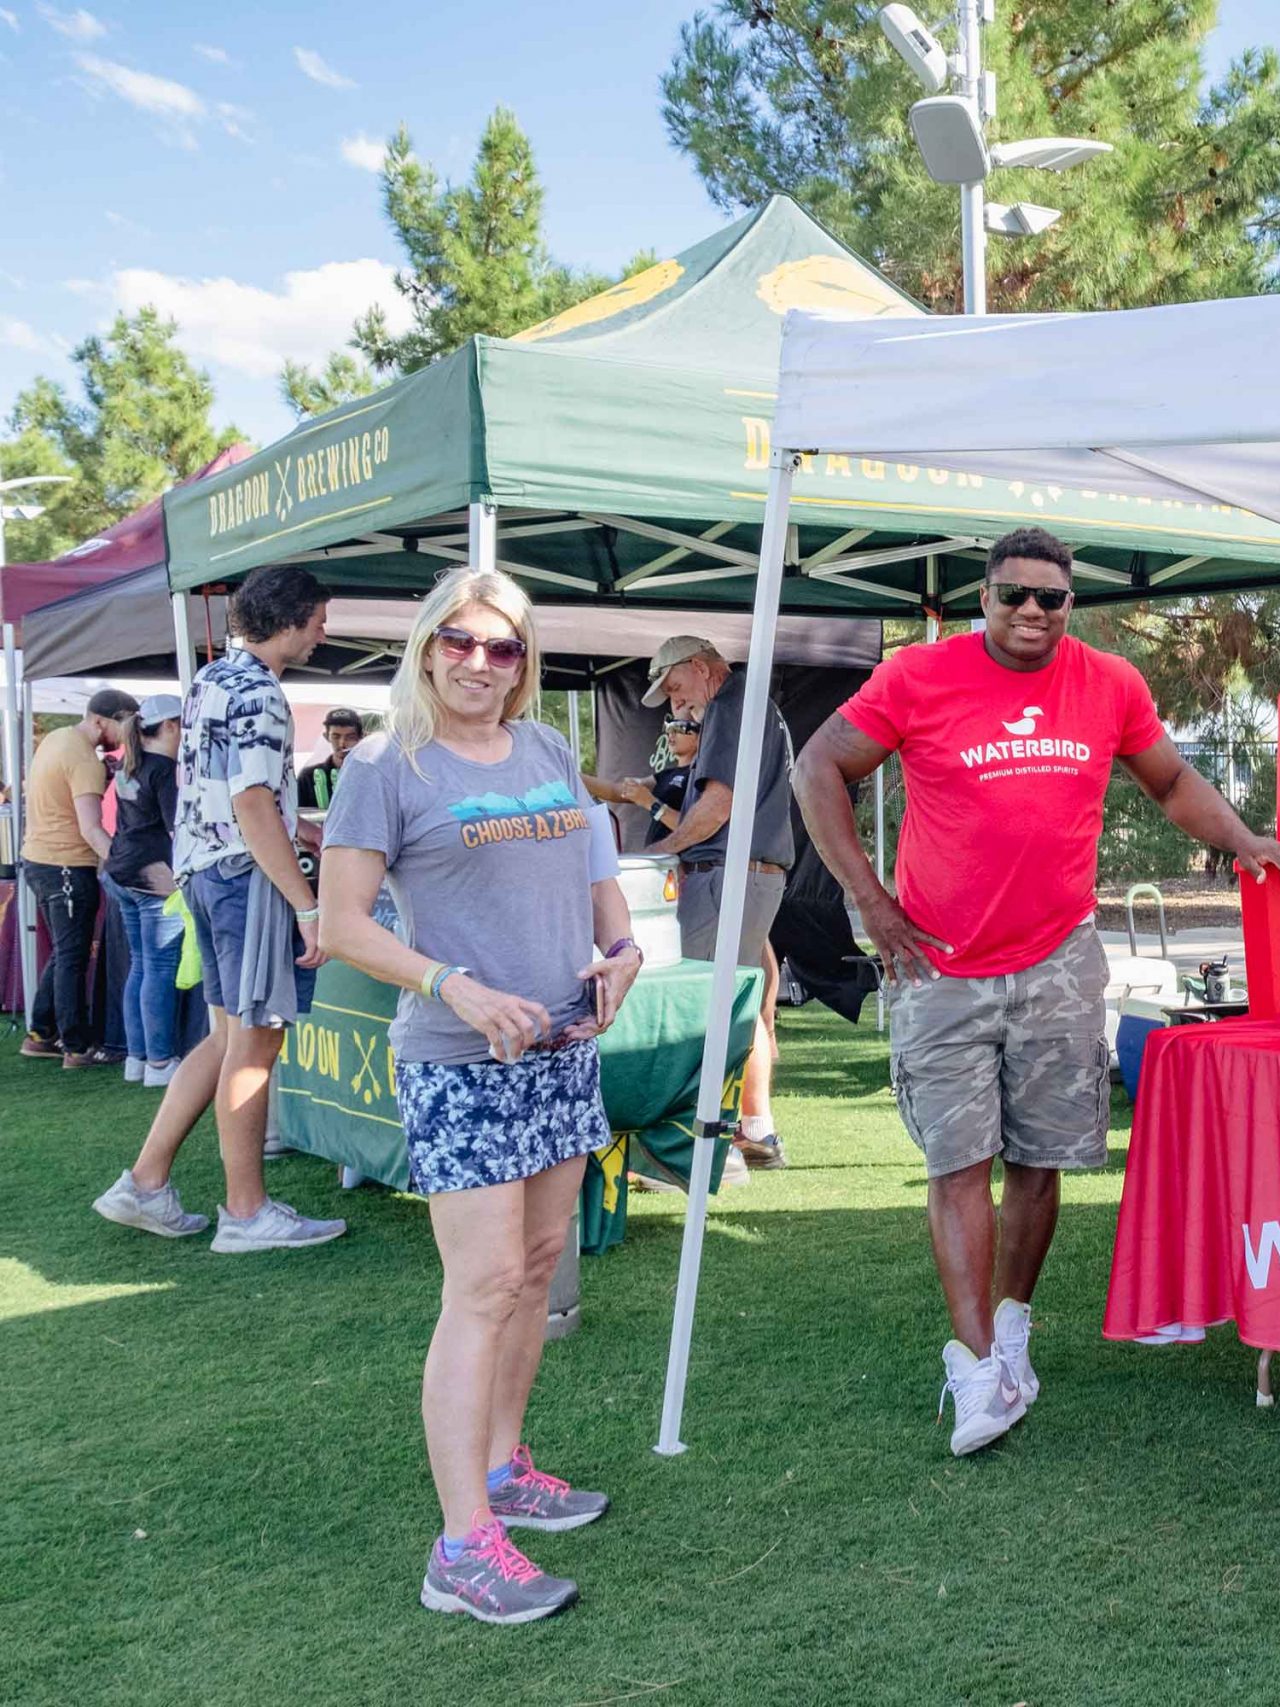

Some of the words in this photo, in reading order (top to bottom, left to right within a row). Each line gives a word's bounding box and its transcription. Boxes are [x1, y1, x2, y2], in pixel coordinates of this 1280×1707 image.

[209, 470, 269, 538] DRAGOON
[297, 431, 373, 503] BREWING
[374, 426, 389, 464] CO
[959, 738, 1091, 768] WATERBIRD
[979, 767, 1013, 782] PREMIUM
[1015, 765, 1051, 775] DISTILLED
[1053, 765, 1079, 776] SPIRITS
